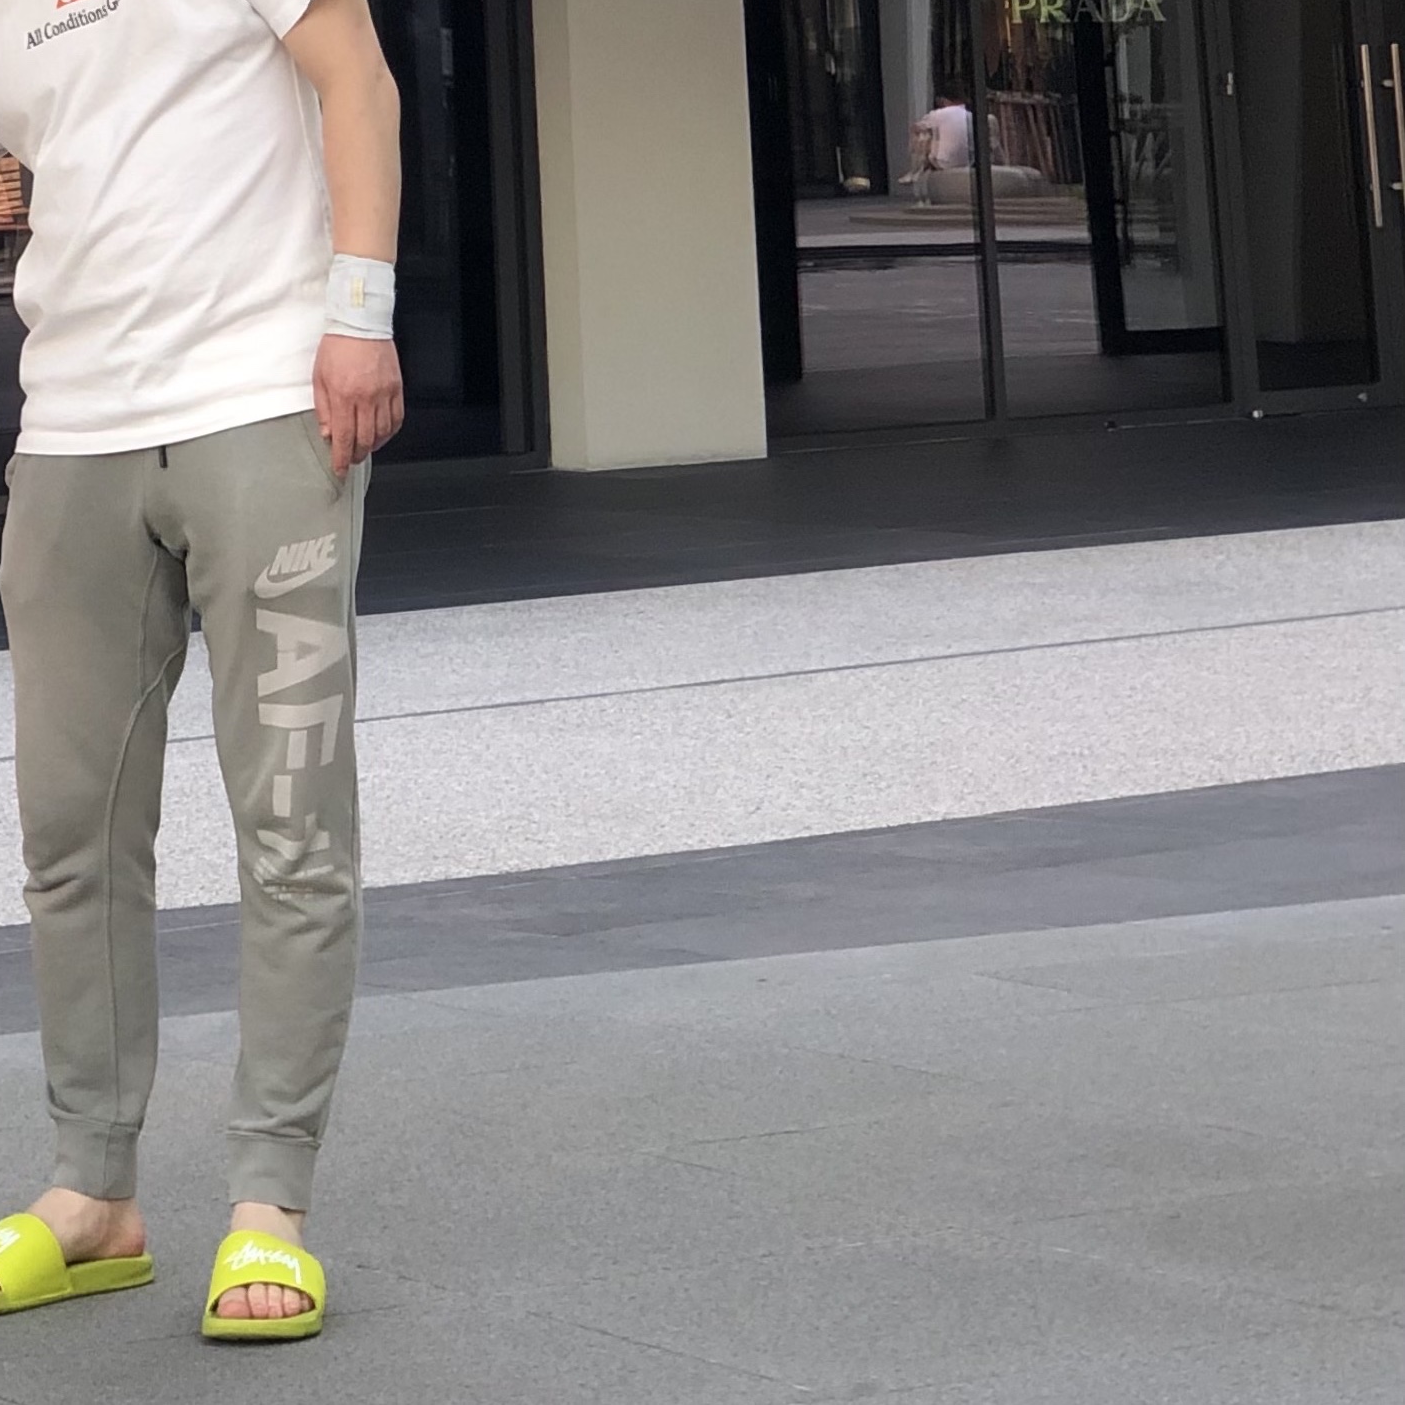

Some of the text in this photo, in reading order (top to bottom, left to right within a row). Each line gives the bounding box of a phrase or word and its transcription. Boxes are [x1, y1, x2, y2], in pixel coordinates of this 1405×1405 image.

[26, 27, 44, 50] All
[44, 4, 108, 40] Conditions
[269, 533, 337, 576] NIKE
